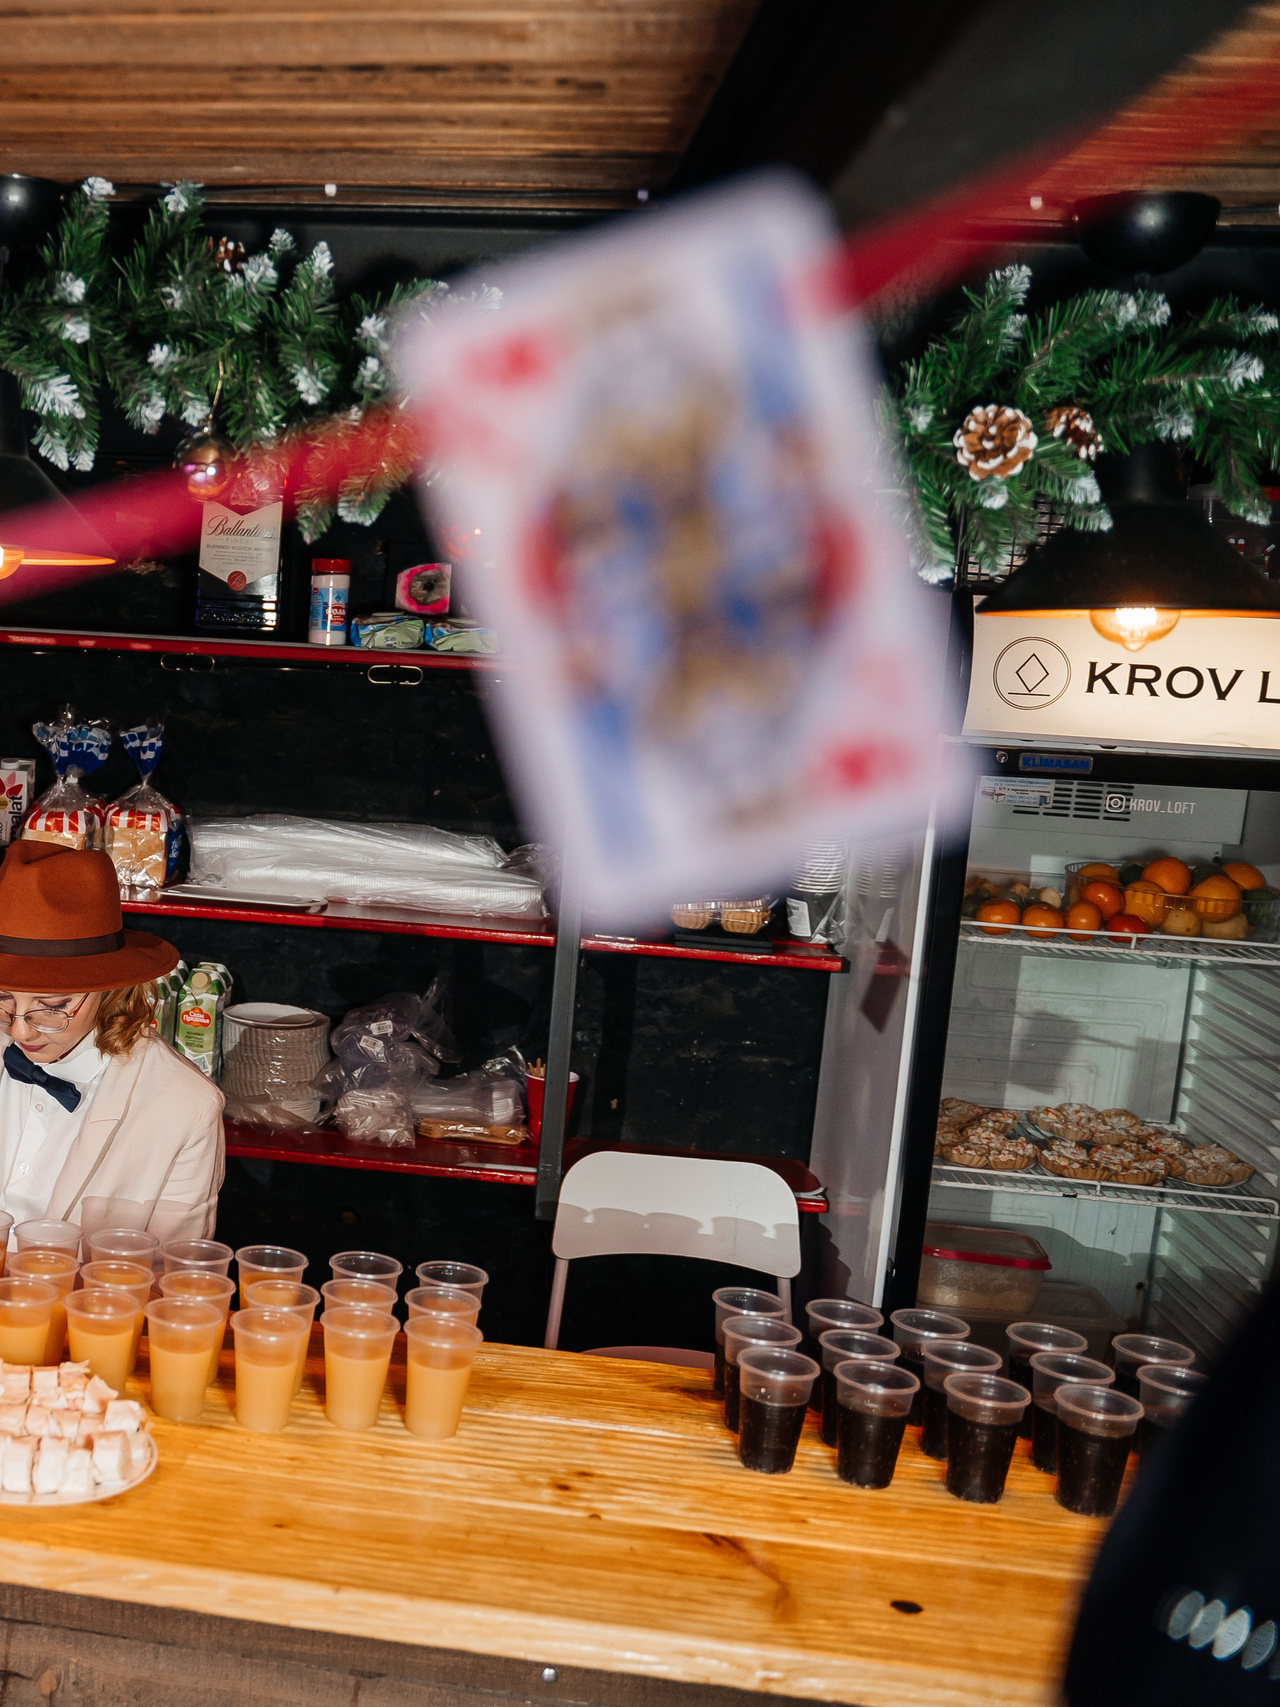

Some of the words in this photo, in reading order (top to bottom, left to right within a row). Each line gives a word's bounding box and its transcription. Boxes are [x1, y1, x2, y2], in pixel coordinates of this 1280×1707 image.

[1084, 661, 1245, 701] KROV
[1129, 798, 1196, 815] KROV_LOFT
[189, 1011, 204, 1019] Сады
